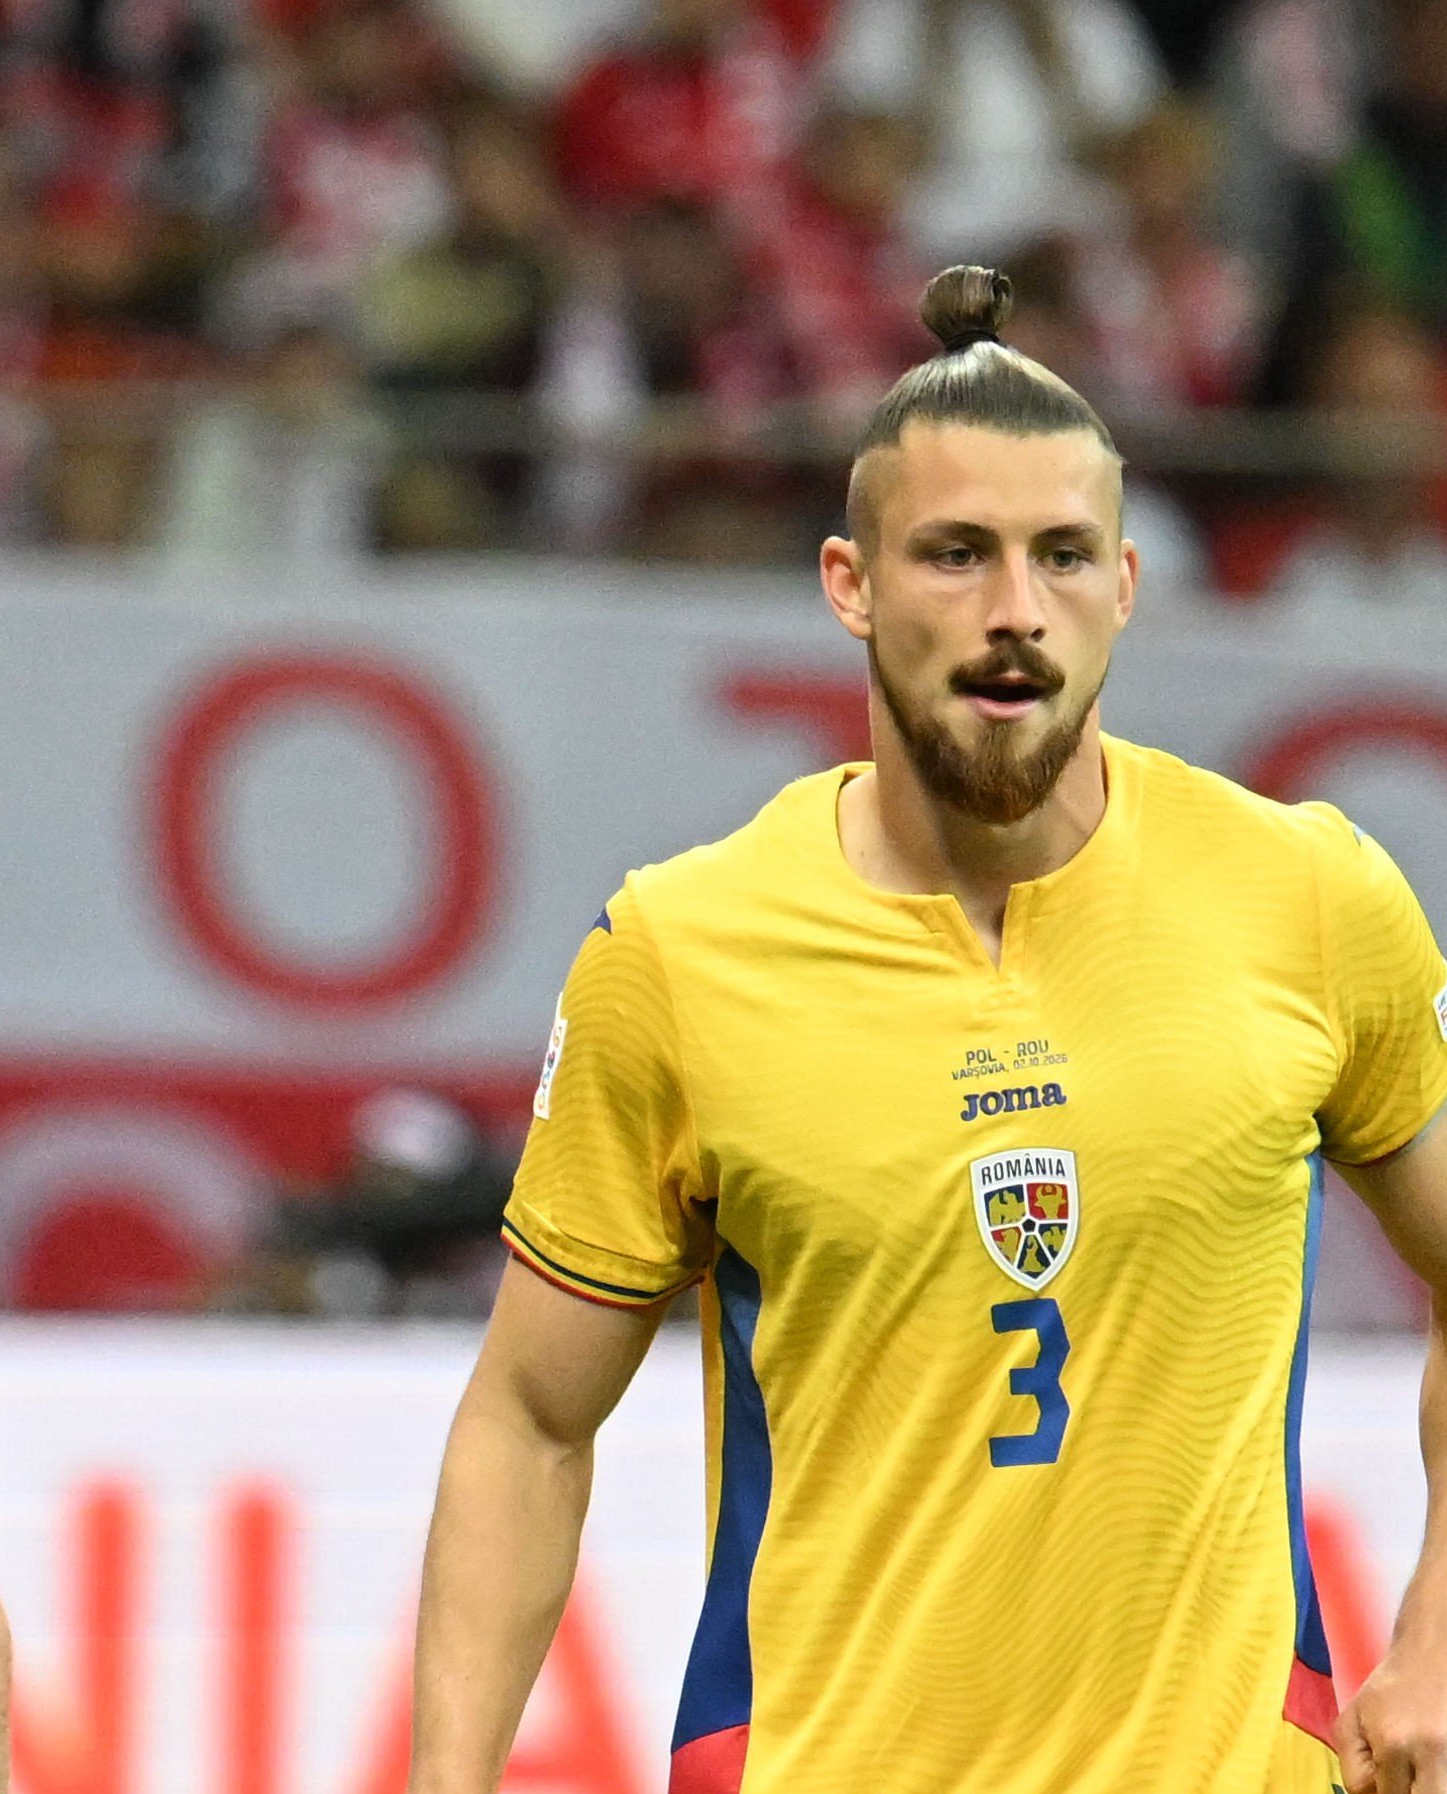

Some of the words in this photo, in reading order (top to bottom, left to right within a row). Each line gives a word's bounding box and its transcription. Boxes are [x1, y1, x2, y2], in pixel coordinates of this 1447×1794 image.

[965, 1048, 997, 1066] POL
[1016, 1039, 1049, 1057] ROU
[981, 1152, 1066, 1186] ROMÂNIA
[989, 1298, 1072, 1467] 3
